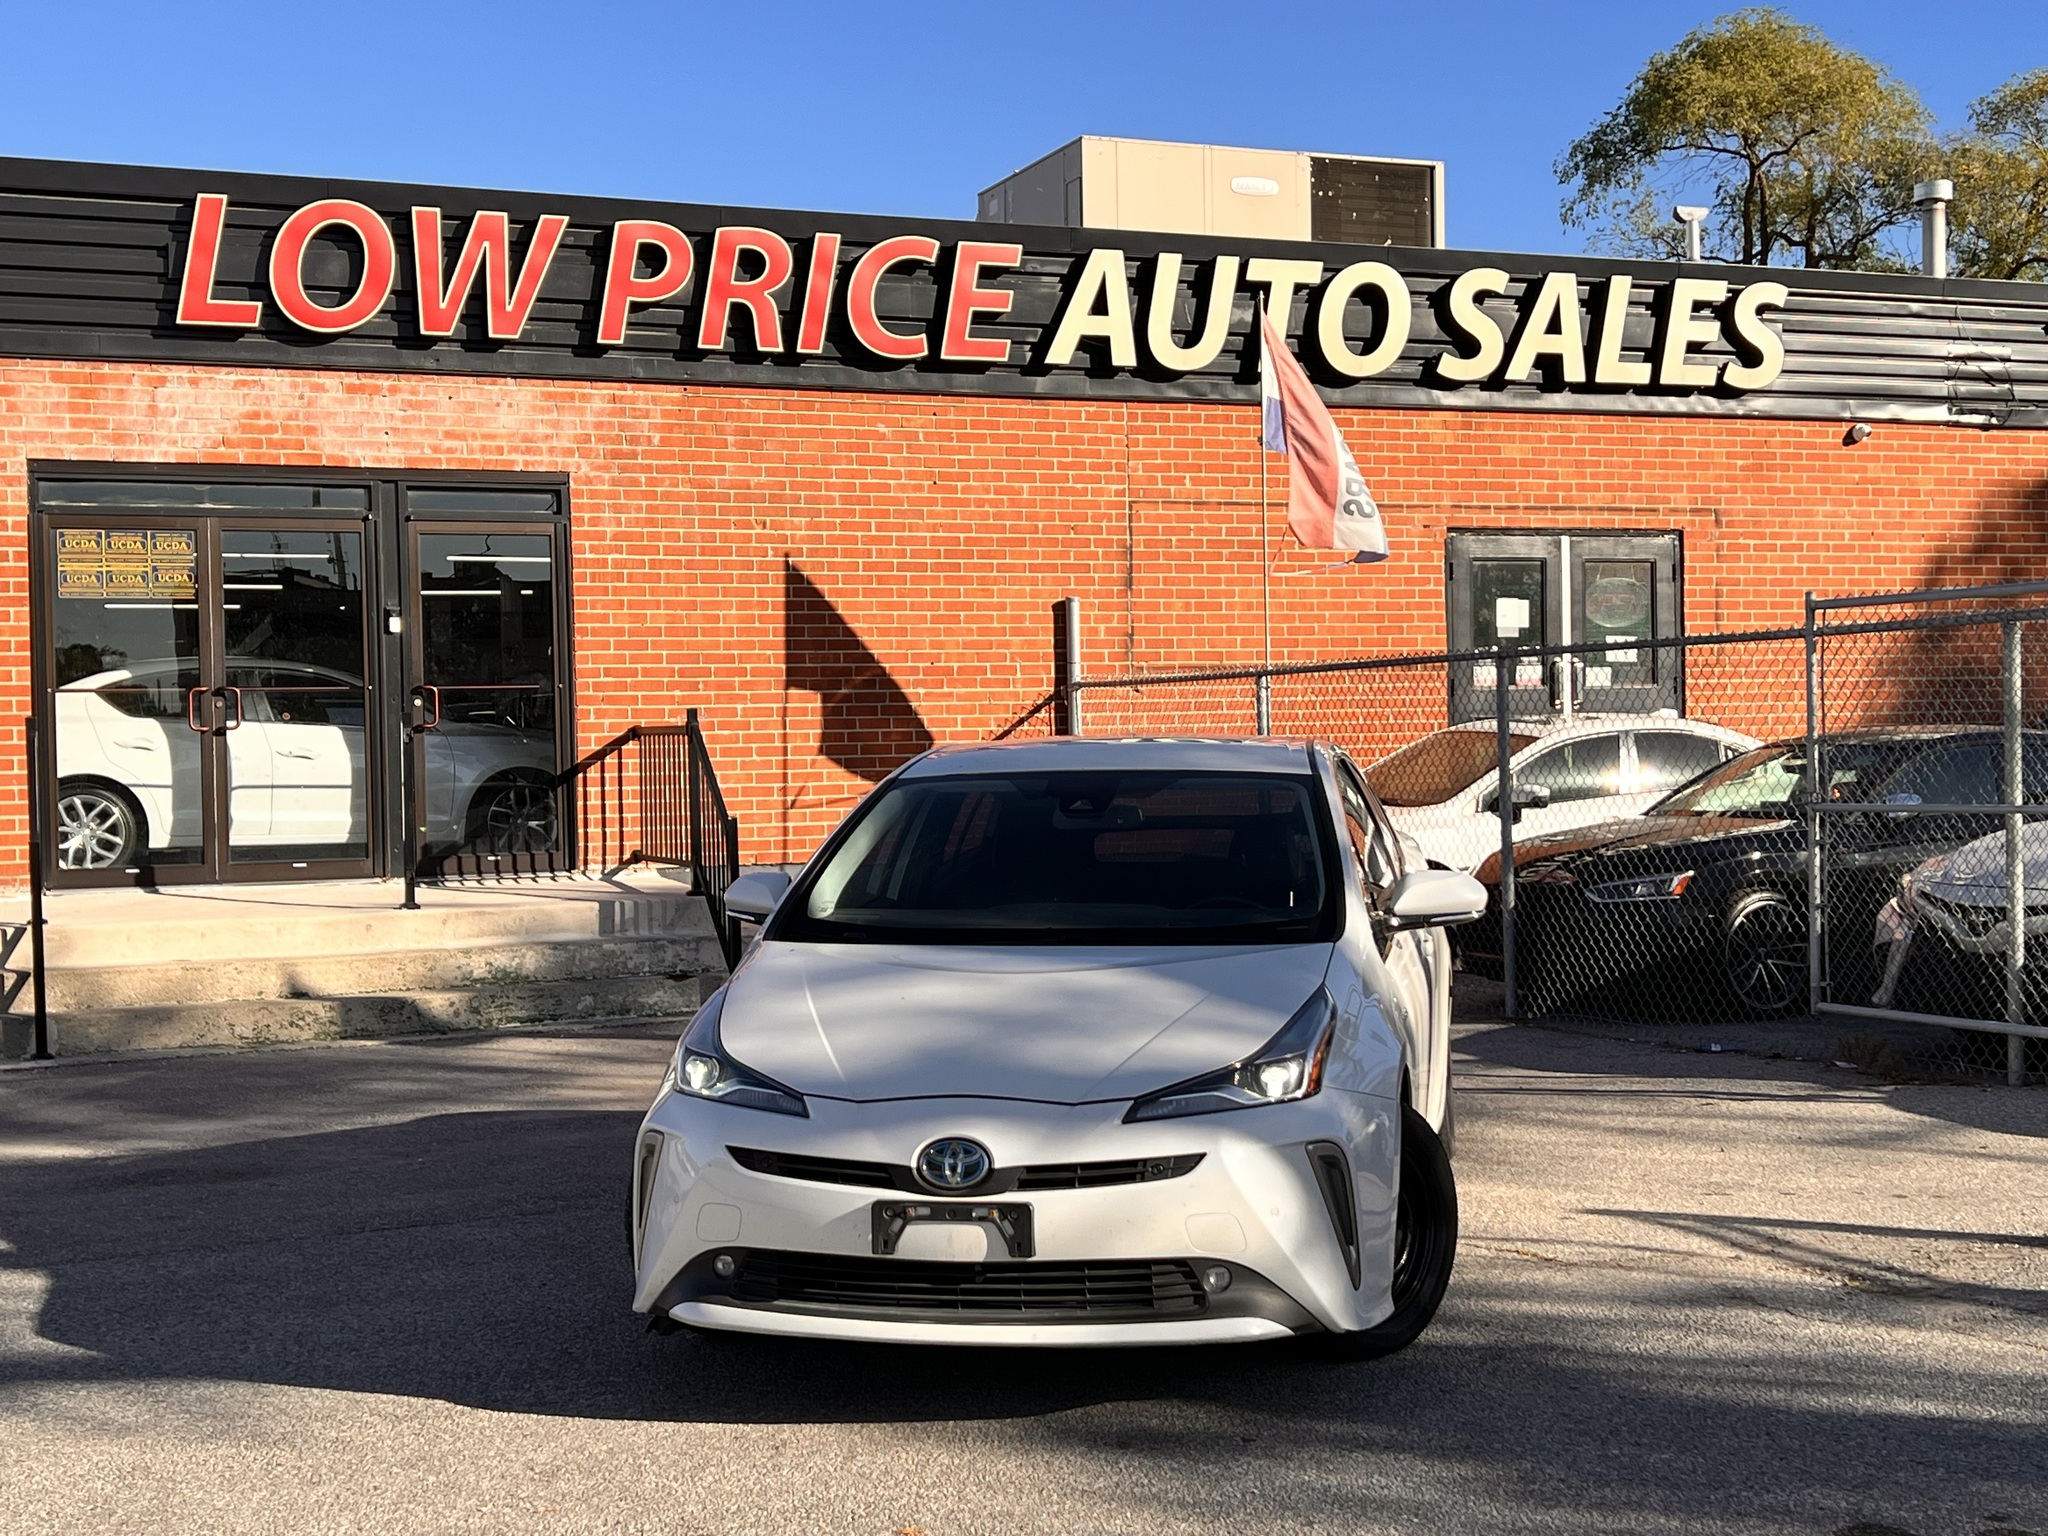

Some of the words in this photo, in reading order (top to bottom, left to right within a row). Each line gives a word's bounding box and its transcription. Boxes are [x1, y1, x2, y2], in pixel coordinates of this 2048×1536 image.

[176, 192, 569, 340] LOW
[597, 219, 1024, 363] PRICE
[1044, 248, 1412, 379] AUTO
[1436, 267, 1789, 391] SALES
[65, 539, 98, 549] UCDA
[111, 540, 143, 550] UCDA
[156, 541, 189, 551] UCDA
[67, 574, 98, 583] UCDA
[112, 574, 143, 583] UCDA
[158, 573, 189, 582] UCDA
